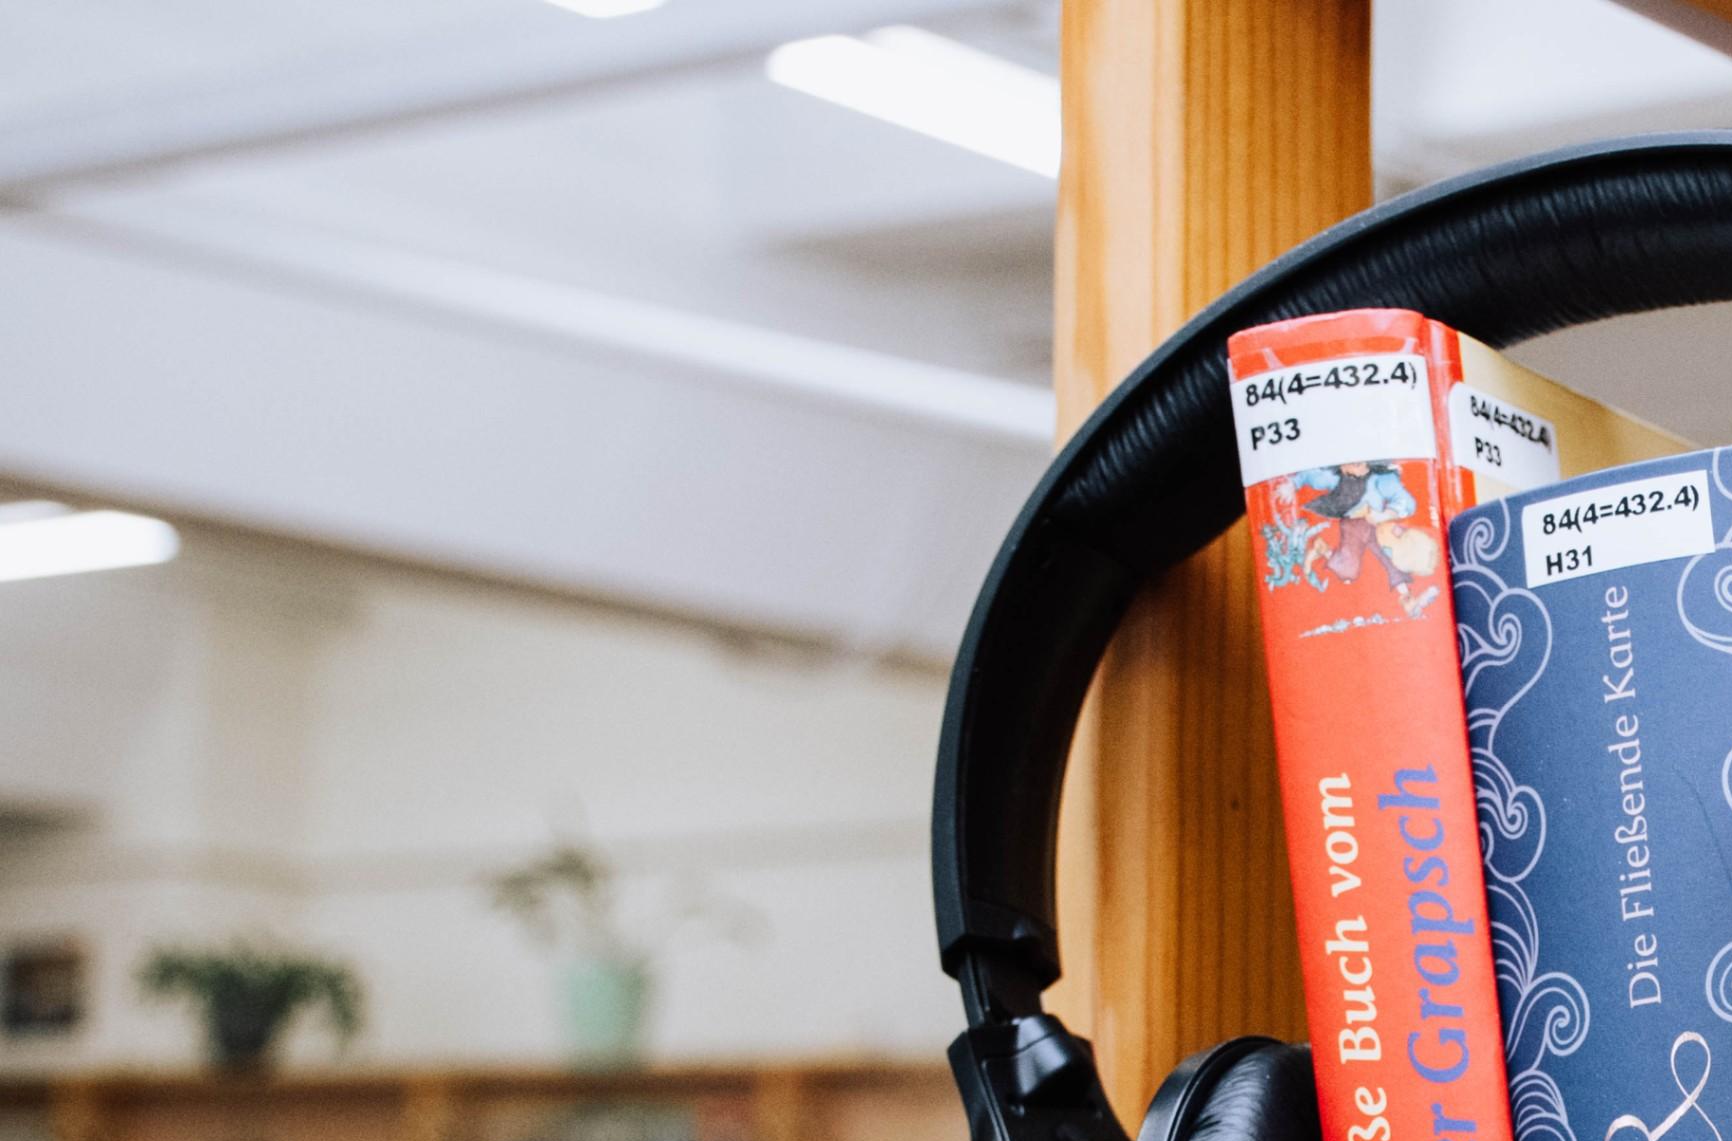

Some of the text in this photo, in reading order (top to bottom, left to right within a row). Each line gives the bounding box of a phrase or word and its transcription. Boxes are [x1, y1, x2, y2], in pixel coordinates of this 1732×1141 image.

[1245, 360, 1418, 407] 84(4=432.4)
[1250, 417, 1302, 450] P33
[1473, 435, 1502, 467] P33
[1541, 483, 1701, 535] 84(4=432.4)
[1545, 545, 1595, 577] H31
[1601, 584, 1662, 1008] Die Fließende Karte
[1317, 771, 1362, 898] vom
[1376, 763, 1476, 1084] Grapsch
[1324, 914, 1382, 1065] Buch
